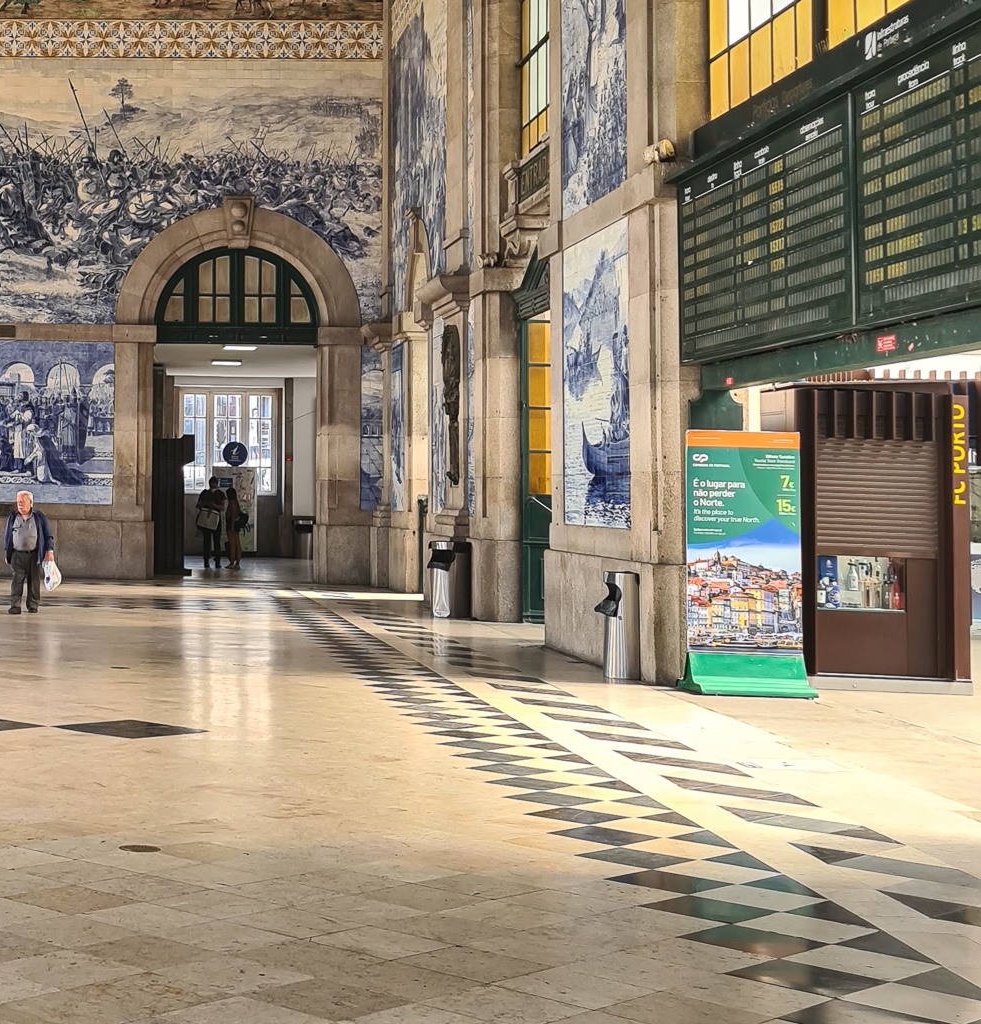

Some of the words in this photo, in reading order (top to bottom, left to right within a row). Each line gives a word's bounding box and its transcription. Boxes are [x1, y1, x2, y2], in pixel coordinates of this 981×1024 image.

[521, 156, 550, 195] ENTRAD
[706, 479, 726, 490] lugar
[727, 481, 746, 490] para
[780, 475, 795, 489] 7€
[692, 489, 708, 497] não
[709, 490, 736, 499] perder
[700, 498, 725, 507] Norte.
[776, 499, 797, 512] 15€
